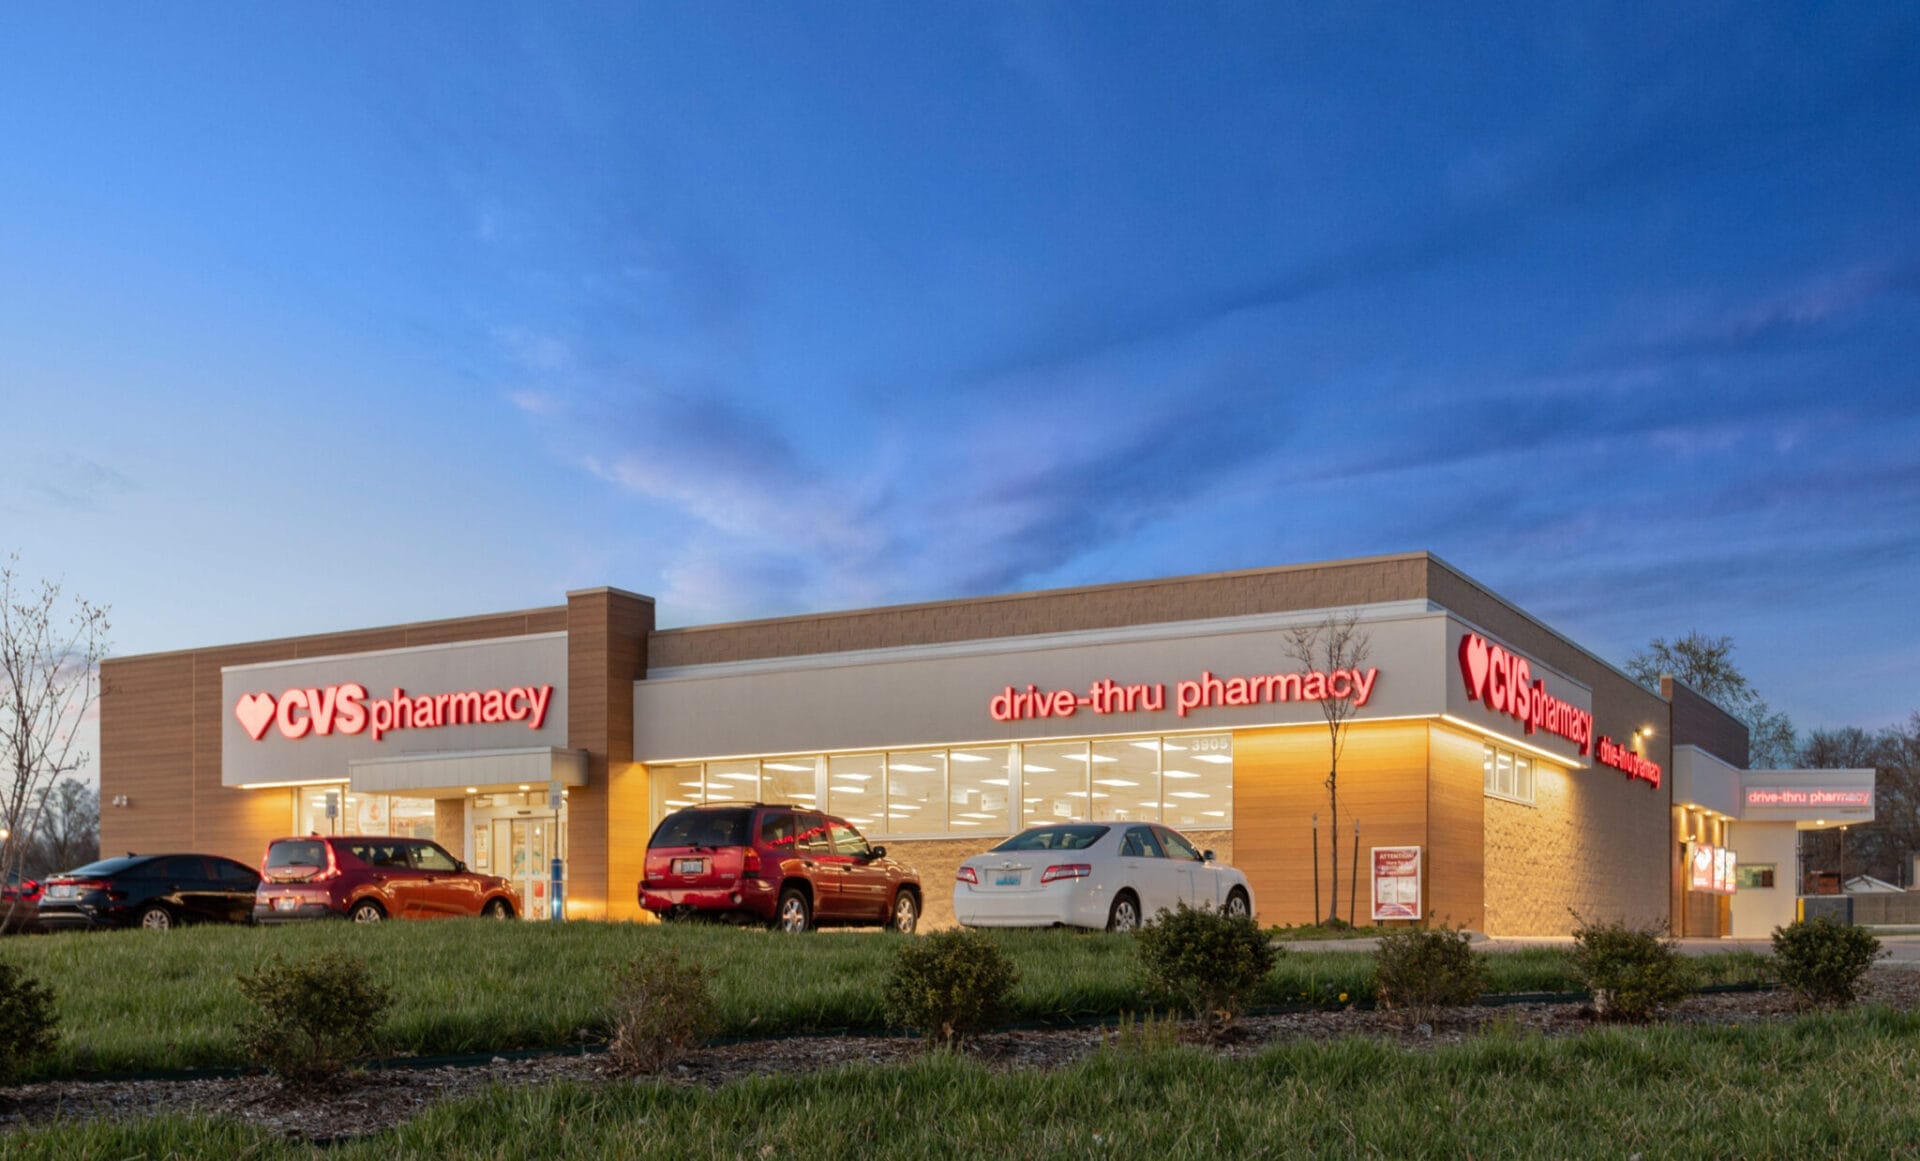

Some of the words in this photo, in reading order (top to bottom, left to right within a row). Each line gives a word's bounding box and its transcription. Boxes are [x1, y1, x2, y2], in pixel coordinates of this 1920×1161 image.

[276, 682, 369, 739] CVS
[371, 684, 553, 741] pharmacy
[990, 679, 1165, 721] drive-thru
[1177, 666, 1377, 717] pharmacy
[1484, 645, 1530, 721] CVS
[1526, 679, 1593, 756] pharmacy
[1191, 738, 1228, 751] 3905
[1748, 789, 1807, 804] drive-thru
[1810, 789, 1870, 806] pharmcy
